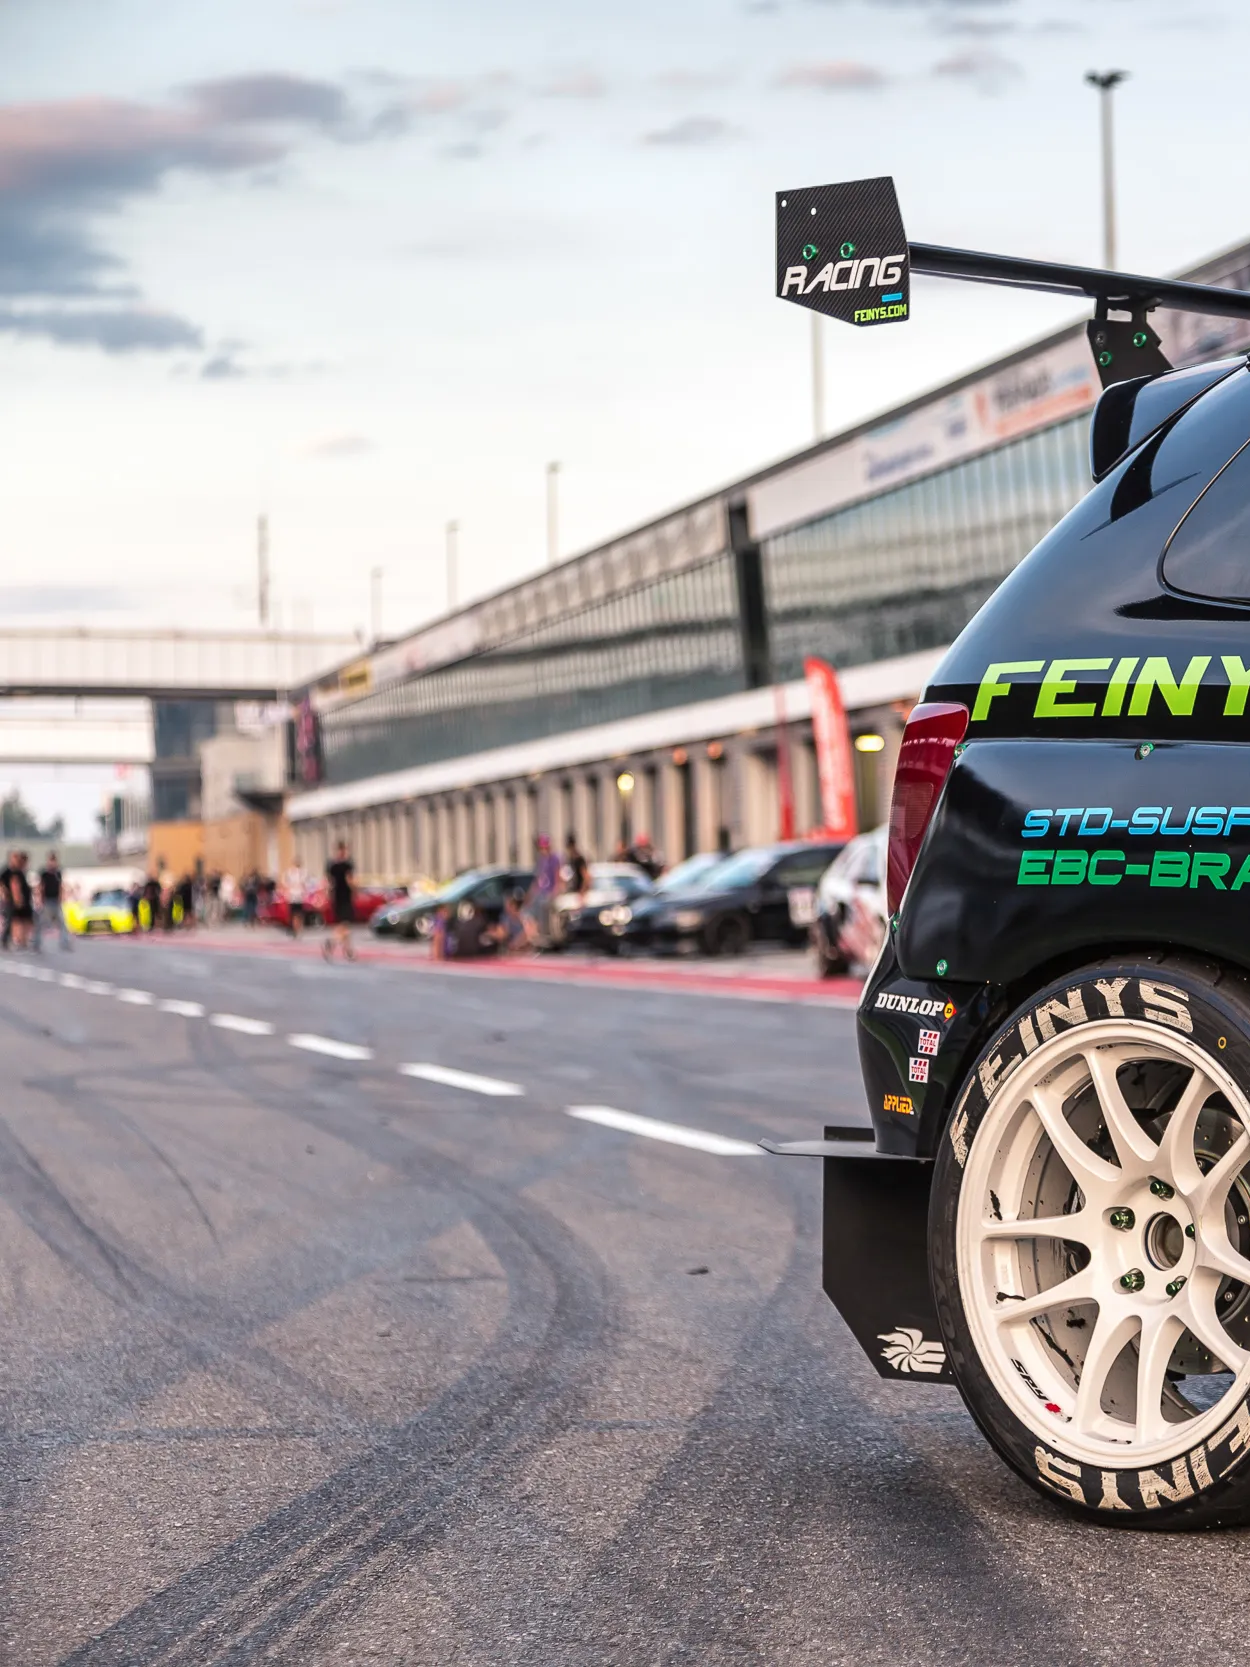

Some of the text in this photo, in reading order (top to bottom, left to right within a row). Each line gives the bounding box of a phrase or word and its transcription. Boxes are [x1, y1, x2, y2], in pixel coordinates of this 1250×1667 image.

[781, 254, 905, 296] RACING
[854, 304, 907, 322] FEINYS.COM
[875, 992, 945, 1017] DUNLOP
[919, 1037, 937, 1047] TOTAL
[911, 1065, 927, 1075] TOTAL
[950, 976, 1193, 1169] FEINYS
